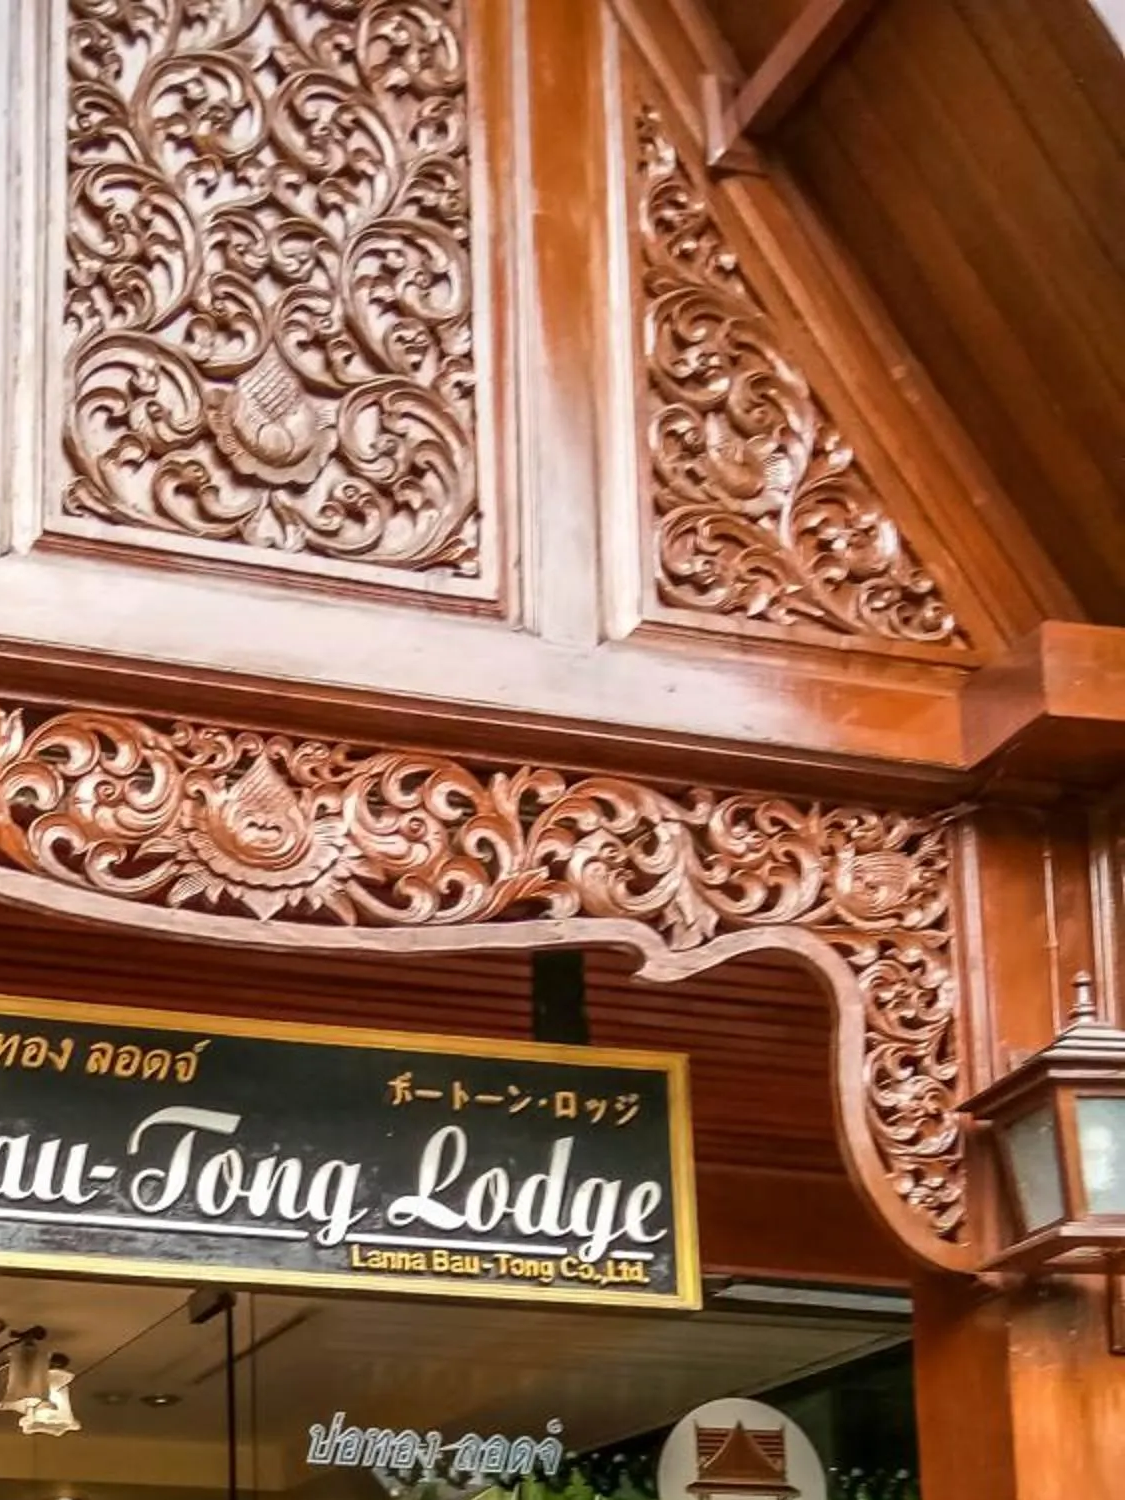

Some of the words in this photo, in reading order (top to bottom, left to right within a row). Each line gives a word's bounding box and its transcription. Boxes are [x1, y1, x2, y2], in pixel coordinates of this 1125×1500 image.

[86, 1039, 212, 1083] ลอดจ์
[386, 1124, 667, 1262] Lodge
[351, 1243, 429, 1272] Lanna
[432, 1249, 556, 1283] Bau-Tong
[306, 1411, 440, 1471] บ่อทอง
[454, 1418, 564, 1477] ลอดจ์
